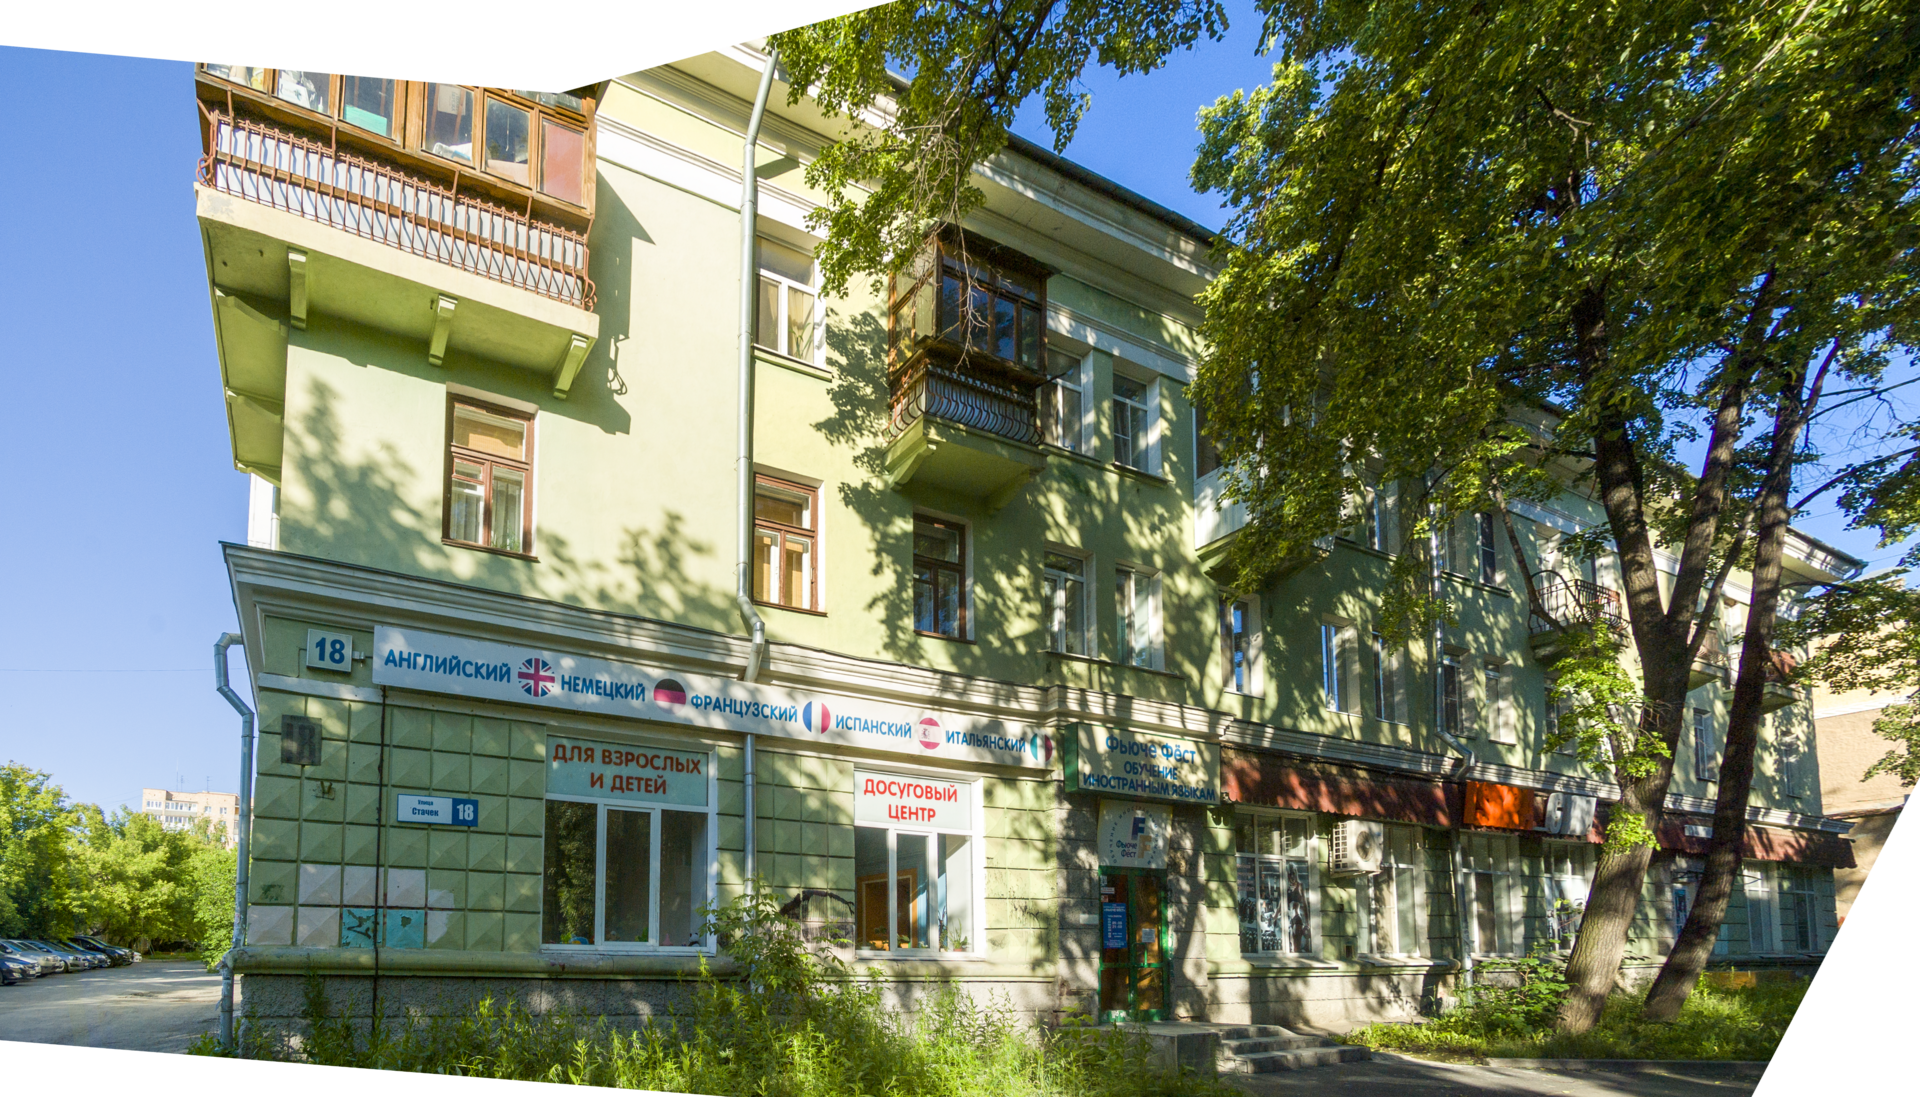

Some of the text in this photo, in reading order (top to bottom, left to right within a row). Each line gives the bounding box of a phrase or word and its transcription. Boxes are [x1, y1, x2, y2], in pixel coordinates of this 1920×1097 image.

[315, 637, 345, 664] 18
[384, 649, 1026, 753] АНГЛИЙСКИЙ НЕМЕЦКИЙ ФРАНЦУЗСКИЙ ИСПАНСКИЙ ИТАЛЬЯНСКИЙ
[552, 744, 702, 775] ДЛЯ ВЗРОСЛЫХ
[1105, 734, 1196, 765] Фьюче Фёст
[590, 772, 666, 795] И ДЕТЕЙ
[1123, 761, 1178, 781] ОБУЧЕНИЕ
[863, 778, 957, 803] ДОСУГОВЫЙ
[1083, 773, 1216, 801] ИНОСТРАННЫМ ЯЗЫКАМ
[411, 807, 439, 817] Стачек
[456, 804, 474, 821] 18
[888, 804, 936, 822] ЦЕНТР
